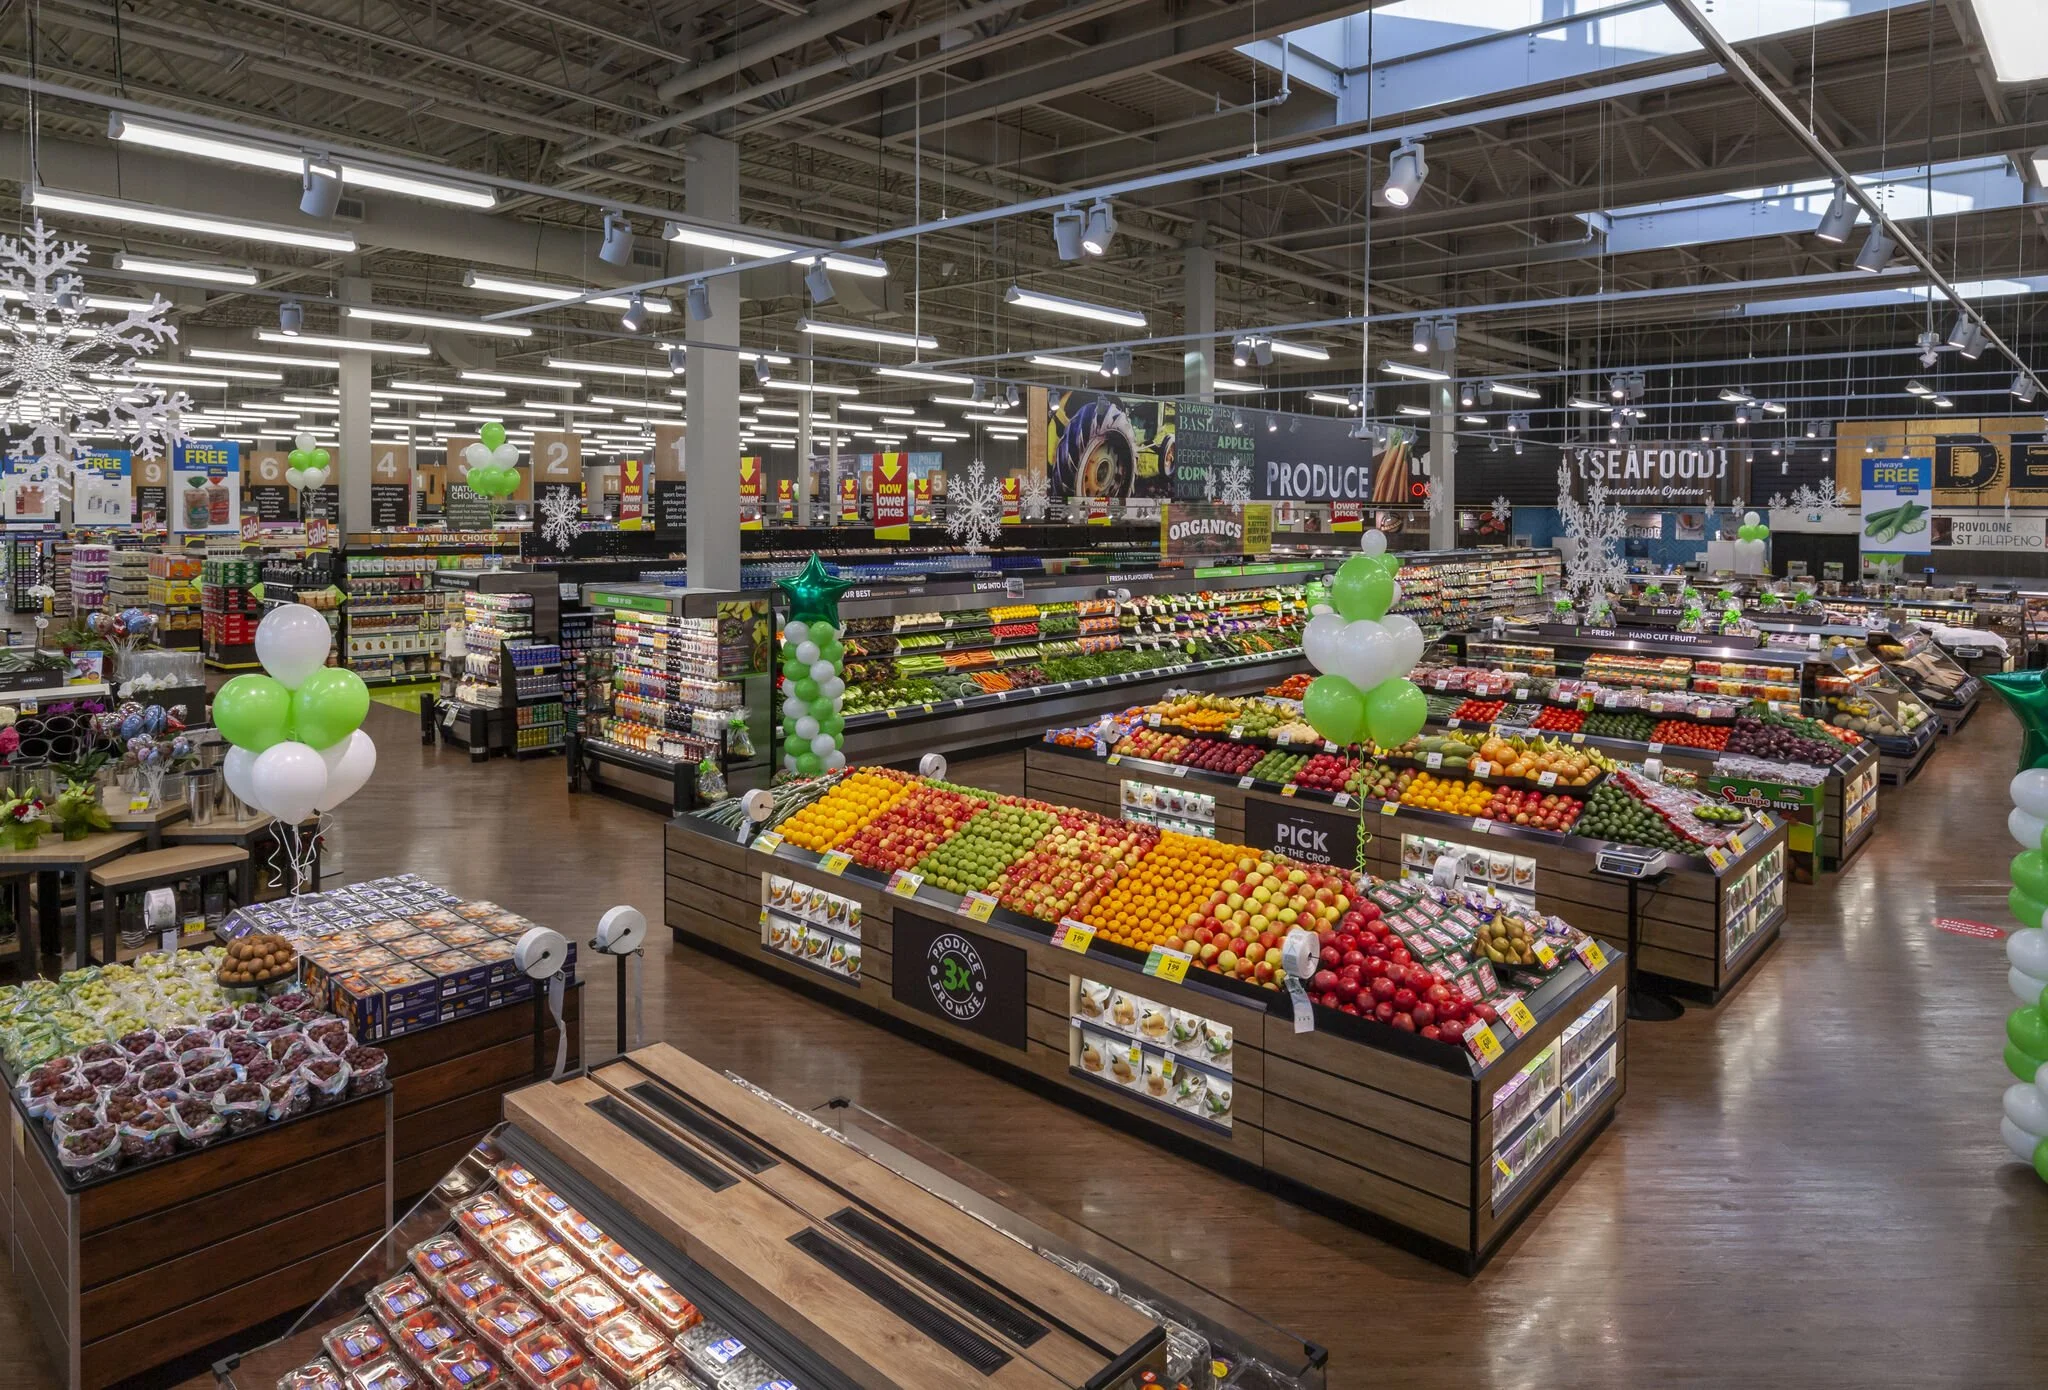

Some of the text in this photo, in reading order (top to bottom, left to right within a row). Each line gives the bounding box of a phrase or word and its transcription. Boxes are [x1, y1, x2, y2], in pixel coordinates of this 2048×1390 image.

[1180, 403, 1231, 418] STRAWBIES
[1180, 416, 1255, 435] BASIL SPINCH
[1217, 435, 1255, 450] APPLES
[85, 458, 121, 469] FREE
[185, 450, 228, 464] FREE
[547, 443, 568, 475] 2
[1177, 449, 1211, 464] PEPPERS
[261, 457, 280, 480] 6
[377, 452, 397, 478] 4
[1874, 461, 1903, 469] always
[145, 464, 160, 482] 9
[1178, 466, 1208, 480] CORN
[1266, 461, 1369, 498] PRODUCE
[1874, 469, 1920, 482] FREE
[625, 485, 640, 494] now
[879, 484, 901, 494] now
[934, 475, 943, 491] 5
[622, 492, 641, 502] lower
[1602, 484, 1704, 498] ustainable Options
[740, 495, 759, 503] ower
[876, 493, 906, 506] lower
[1333, 502, 1360, 510] lower
[623, 504, 640, 513] prices
[878, 508, 904, 519] prices
[1334, 509, 1359, 518] prices
[243, 521, 258, 541] sale
[308, 522, 327, 545] sale
[1169, 519, 1242, 540] ORGANICS
[1625, 526, 1661, 539] EAFOOD
[1952, 522, 2012, 533] PROVOLONE
[1247, 535, 1268, 544] GROW
[1976, 535, 2042, 547] JALAPENO
[856, 589, 871, 597] BEST
[1591, 629, 1615, 637] FRESH
[1629, 632, 1653, 641] HAND
[1653, 633, 1670, 641] CUT
[1669, 635, 1697, 644] FRUIT?
[1721, 786, 1771, 808] Sunripe
[1773, 800, 1800, 811] NUTS
[1277, 823, 1329, 853] PICK
[1274, 845, 1331, 864] OF THE CROP
[932, 938, 981, 972] PRODUCE
[943, 958, 971, 991] 3x
[932, 982, 981, 1016] PROMISE
